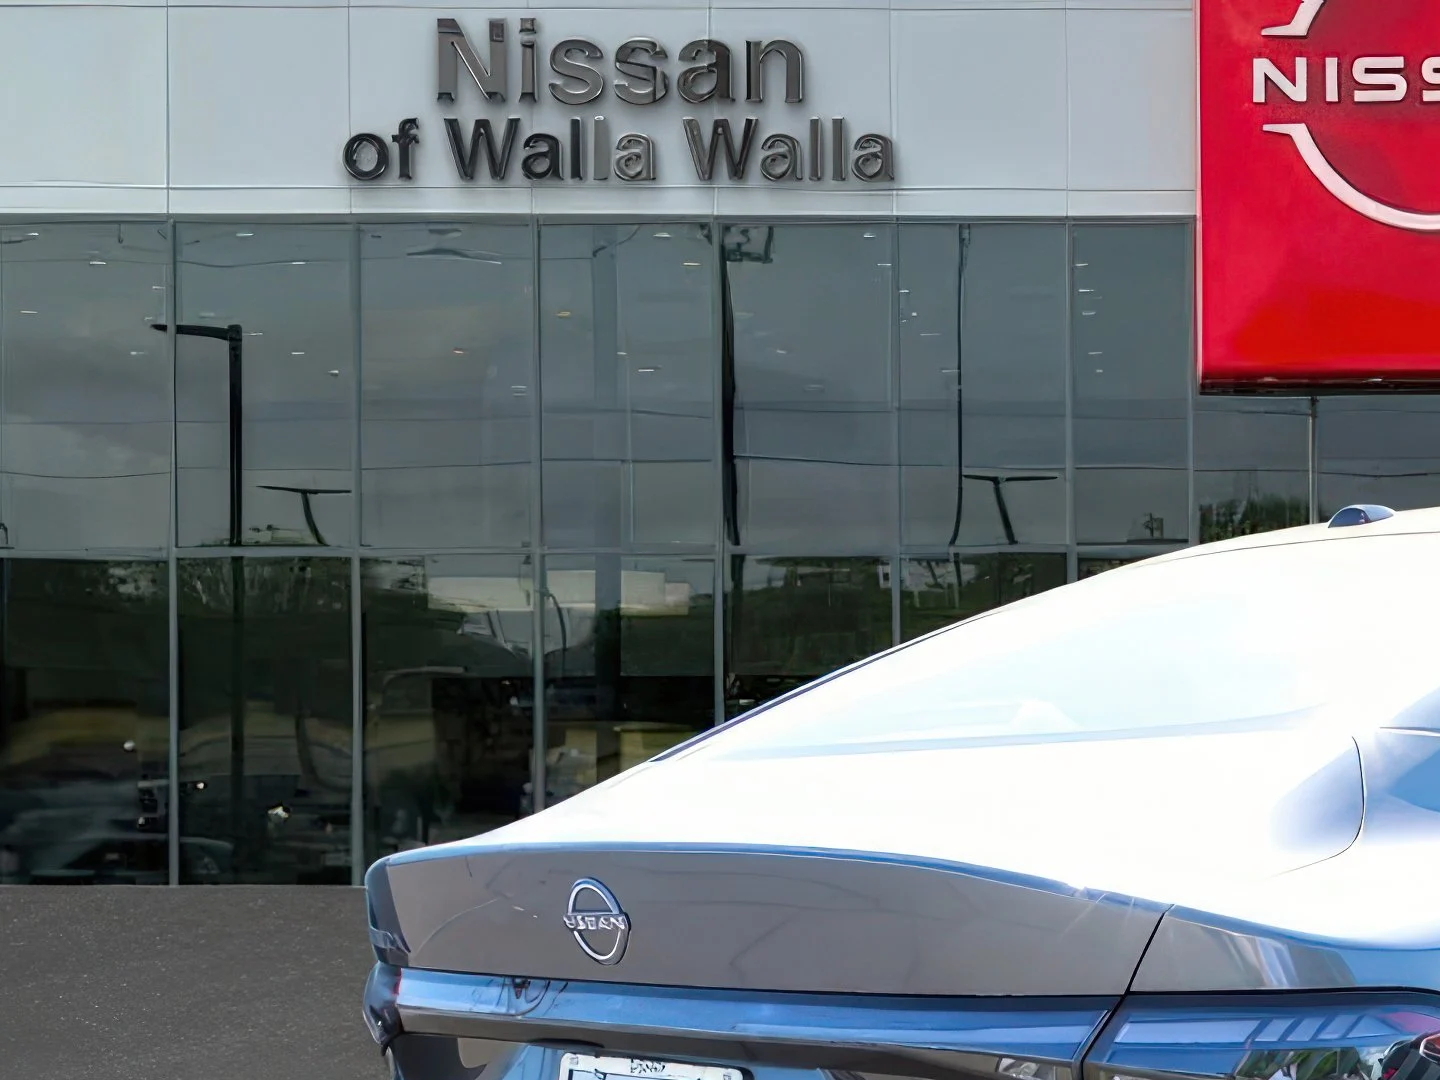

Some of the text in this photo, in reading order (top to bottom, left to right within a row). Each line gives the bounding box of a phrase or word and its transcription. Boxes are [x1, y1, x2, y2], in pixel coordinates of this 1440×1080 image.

[437, 18, 804, 104] Nissan
[342, 116, 895, 181] of Walla Walla
